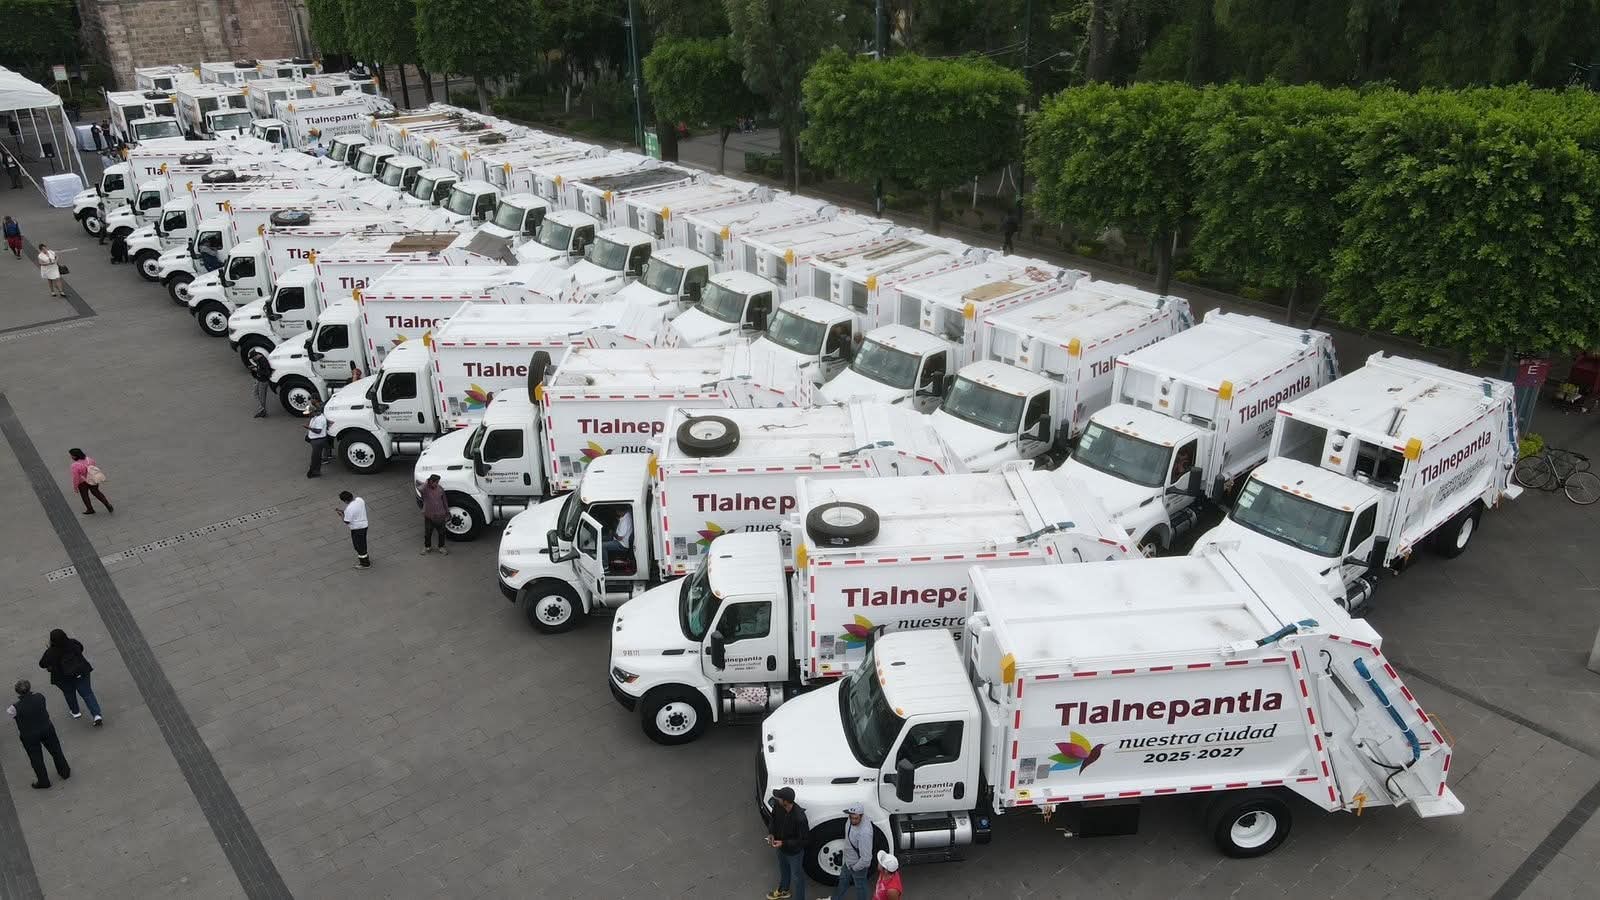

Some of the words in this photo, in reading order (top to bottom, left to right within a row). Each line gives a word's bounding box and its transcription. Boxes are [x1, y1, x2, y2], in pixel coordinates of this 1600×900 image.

[463, 362, 528, 377] Tlalne
[577, 418, 665, 437] Tlalnep
[1421, 431, 1491, 486] Tlalnepantla
[692, 493, 796, 514] Tlalnep
[745, 524, 782, 532] nues
[1055, 689, 1283, 726] Tlalnepantla
[1118, 733, 1201, 749] nuestra
[1204, 724, 1278, 743] ciudad
